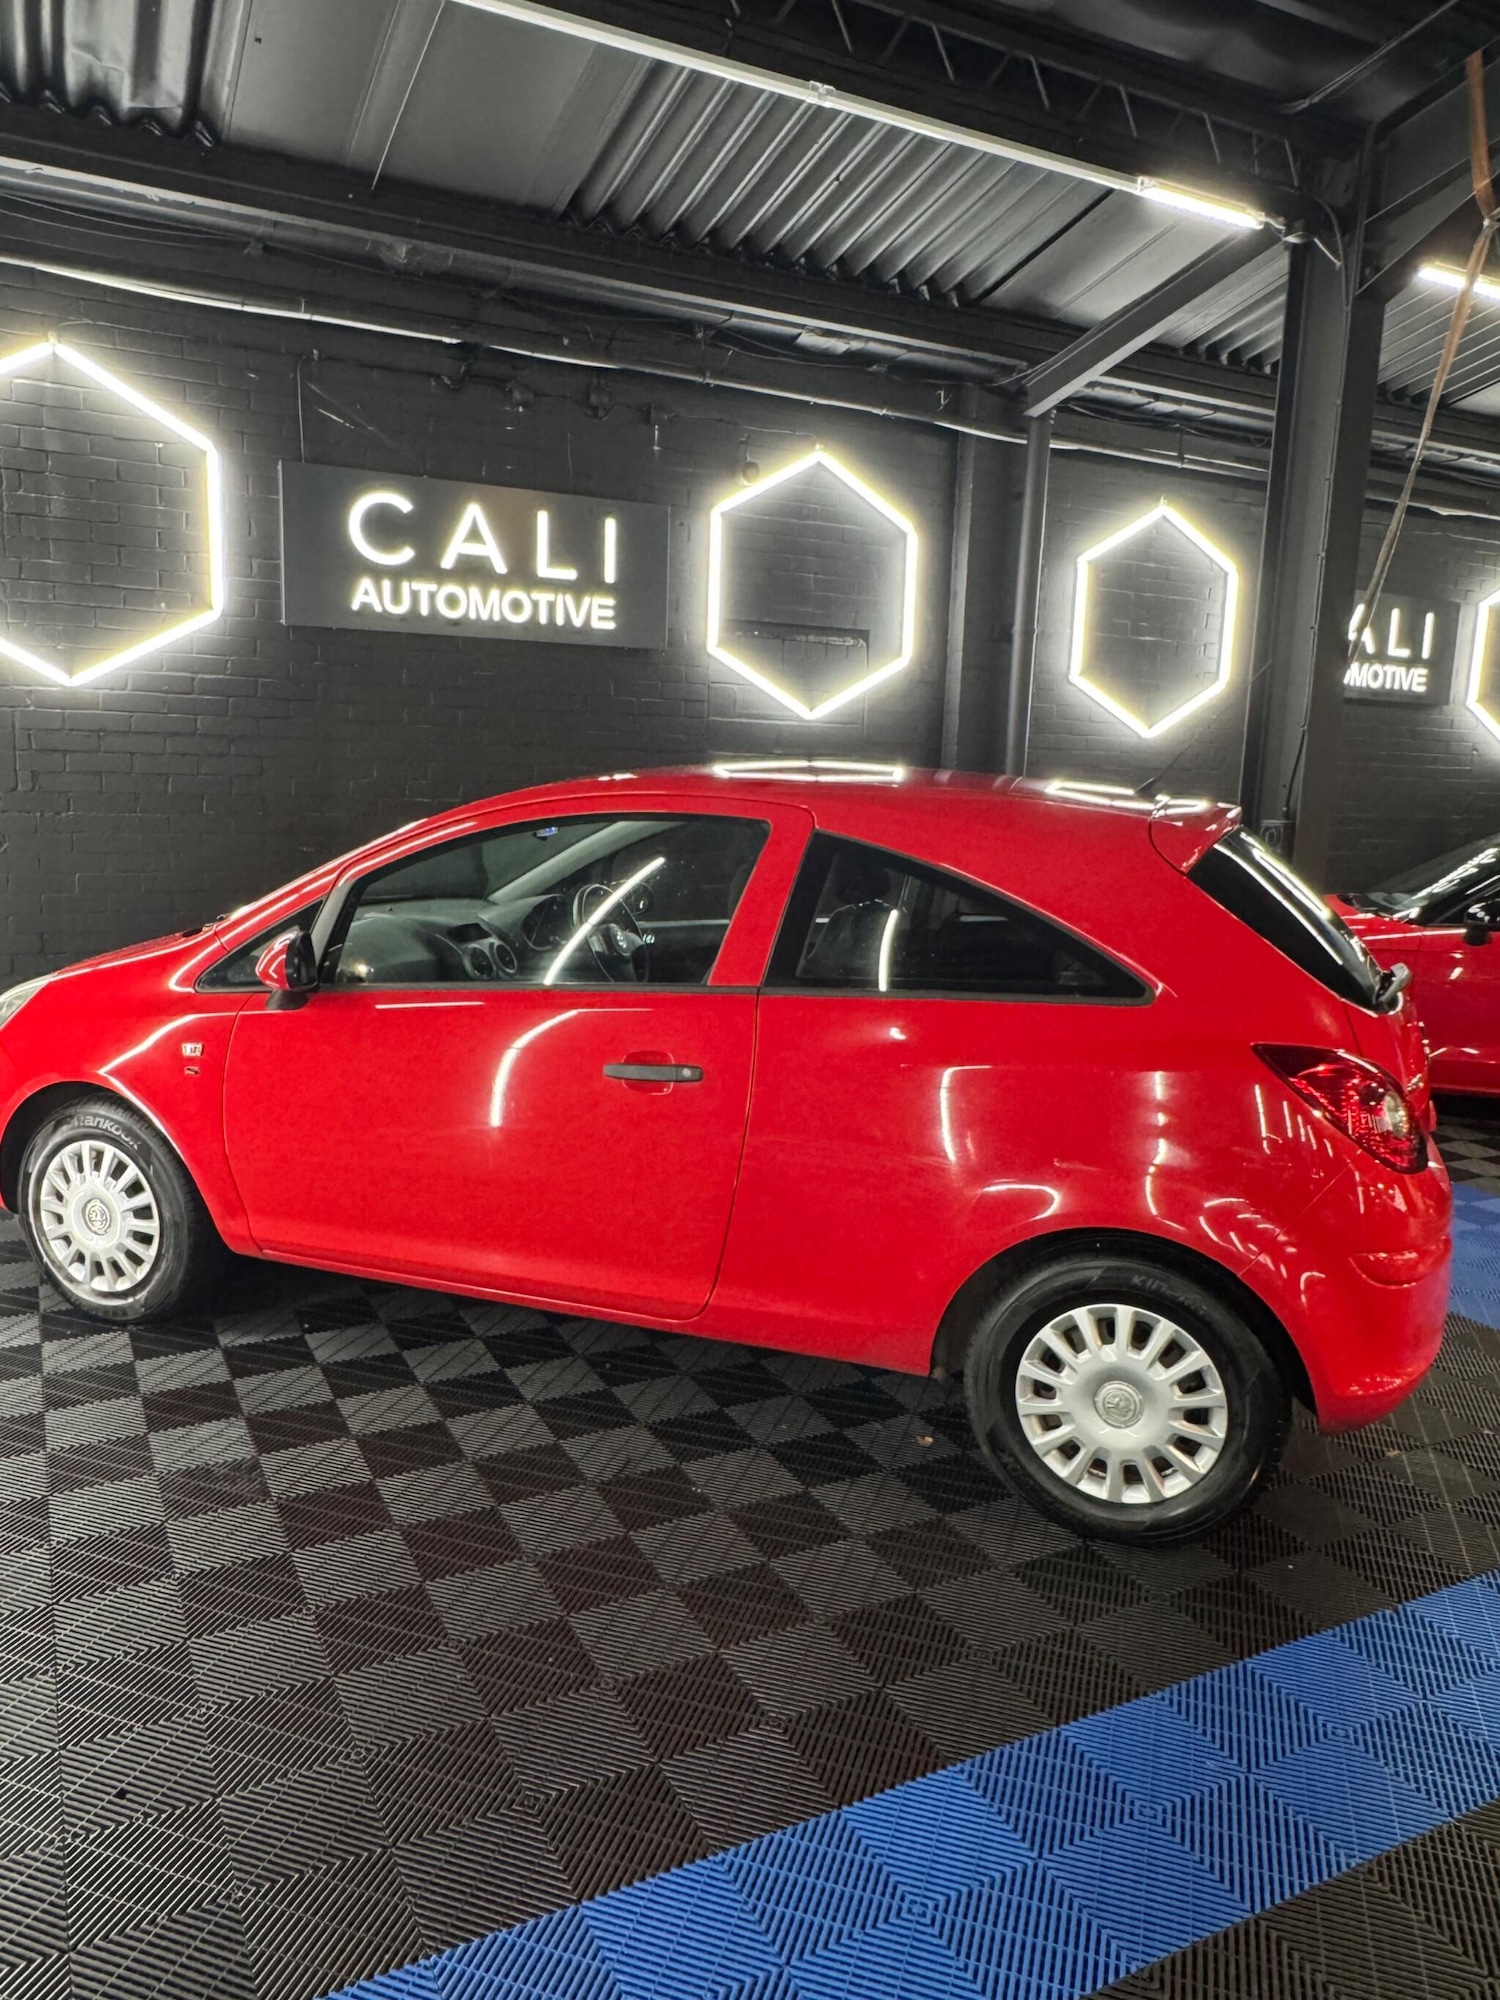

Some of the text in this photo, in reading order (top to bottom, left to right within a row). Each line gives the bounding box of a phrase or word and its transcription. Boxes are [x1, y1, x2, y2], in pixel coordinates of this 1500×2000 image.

[347, 489, 617, 584] CALI
[350, 576, 617, 631] AUTOMOTIVE
[1347, 603, 1435, 660] ALI
[1343, 661, 1429, 693] MOTIVE
